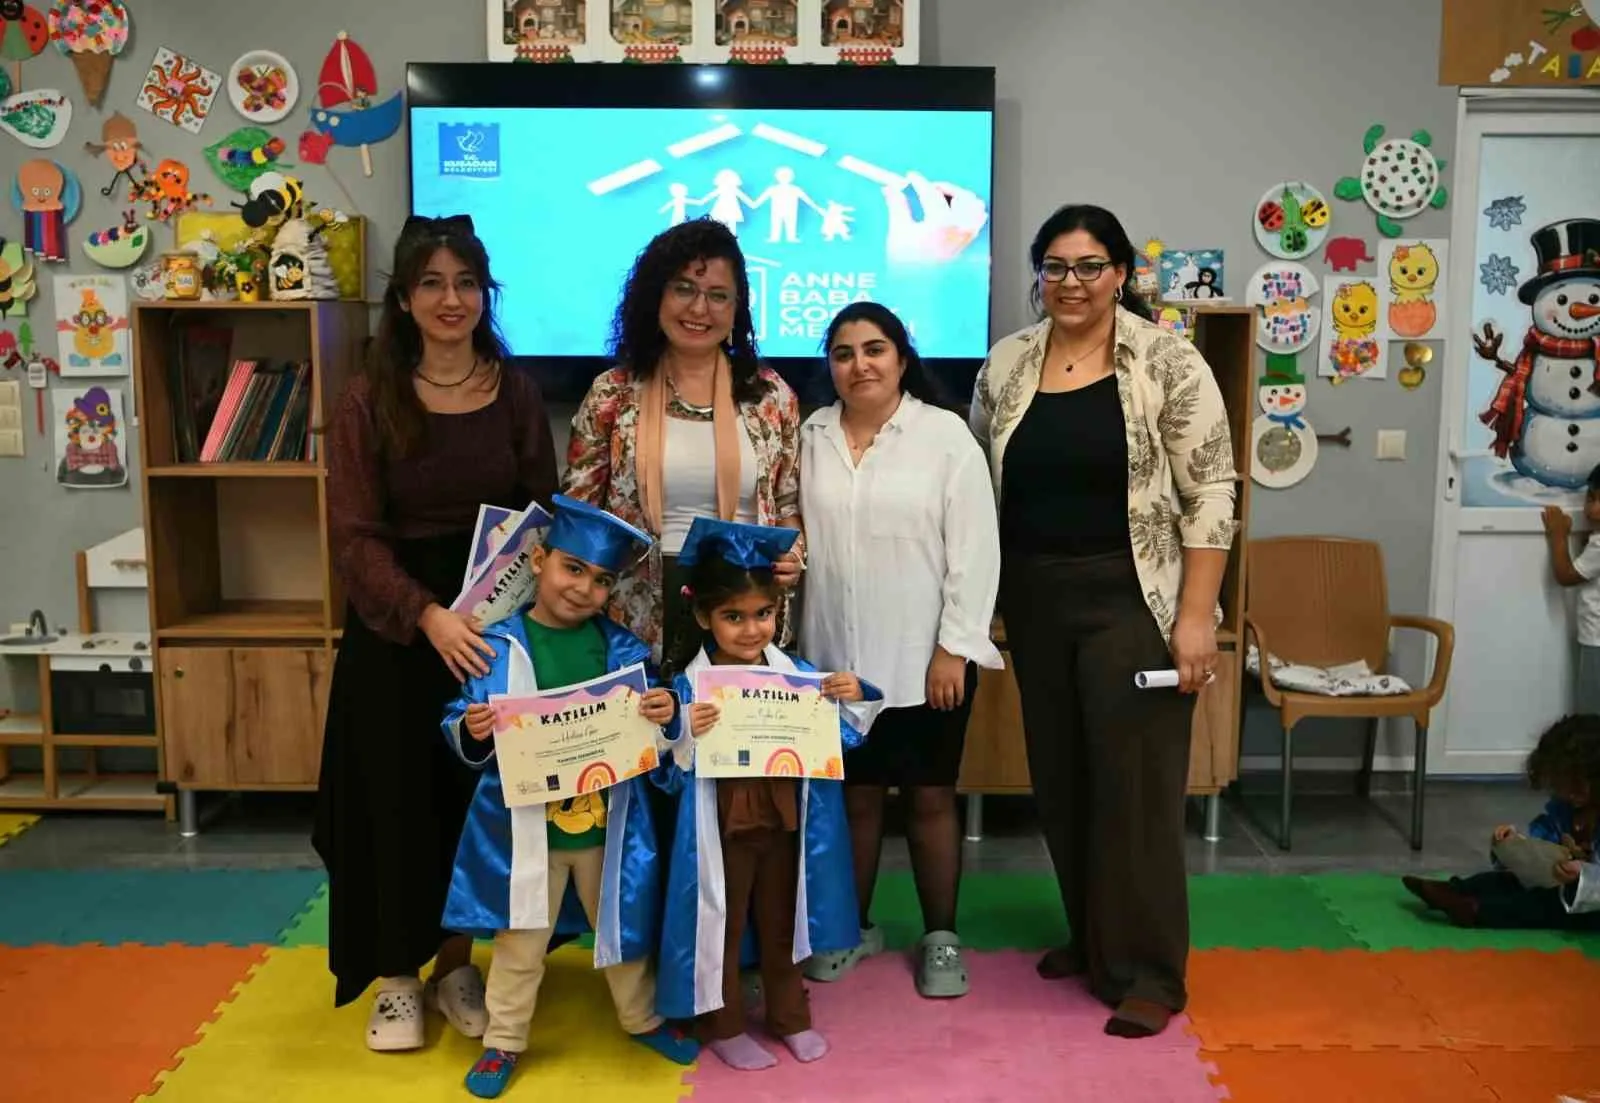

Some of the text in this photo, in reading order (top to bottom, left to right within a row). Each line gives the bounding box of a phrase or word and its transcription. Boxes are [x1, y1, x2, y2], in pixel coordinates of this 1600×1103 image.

[781, 271, 877, 288] ANNE
[779, 289, 873, 305] BABA
[485, 551, 529, 604] KATILIM
[742, 688, 800, 704] KATILIM
[540, 701, 607, 725] KATILIM
